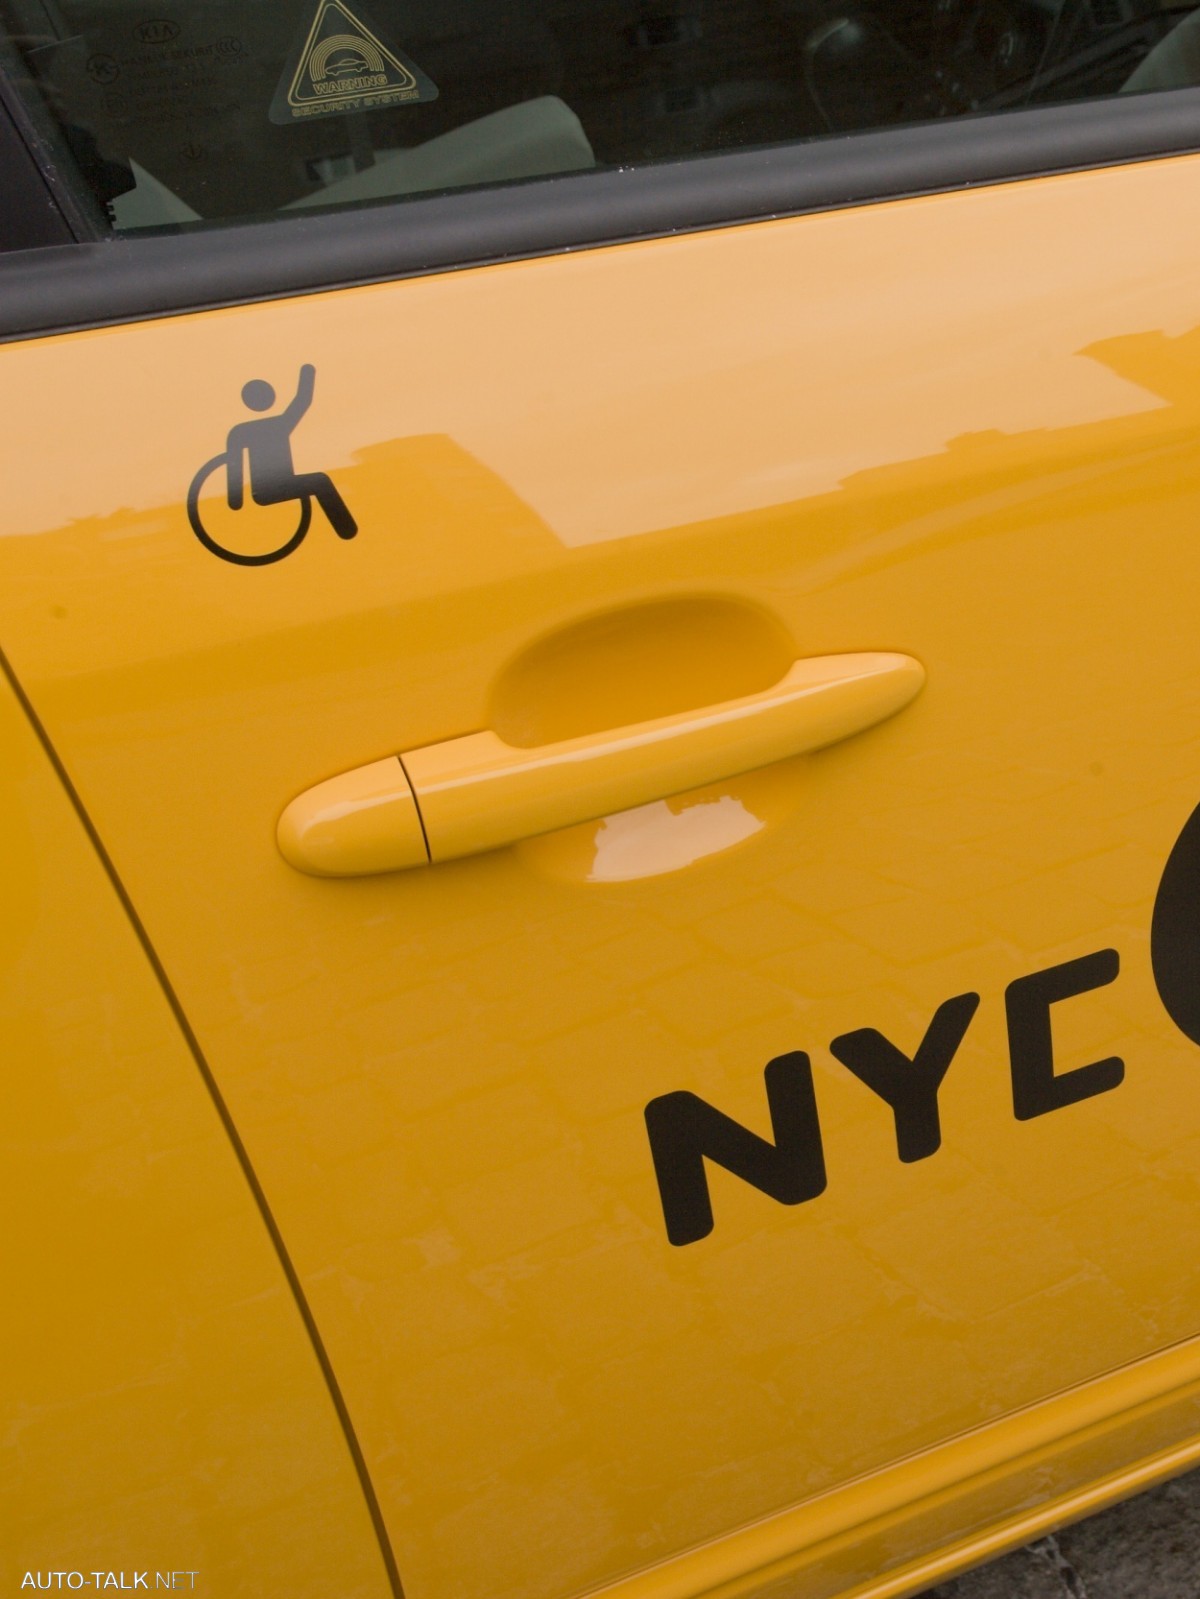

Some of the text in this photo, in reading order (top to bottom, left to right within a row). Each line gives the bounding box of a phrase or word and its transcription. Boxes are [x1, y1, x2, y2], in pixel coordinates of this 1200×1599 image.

[139, 24, 174, 39] KIA
[312, 73, 388, 95] WARNING
[291, 89, 420, 118] SECURITY SYSTEM
[643, 948, 1125, 1246] NYC
